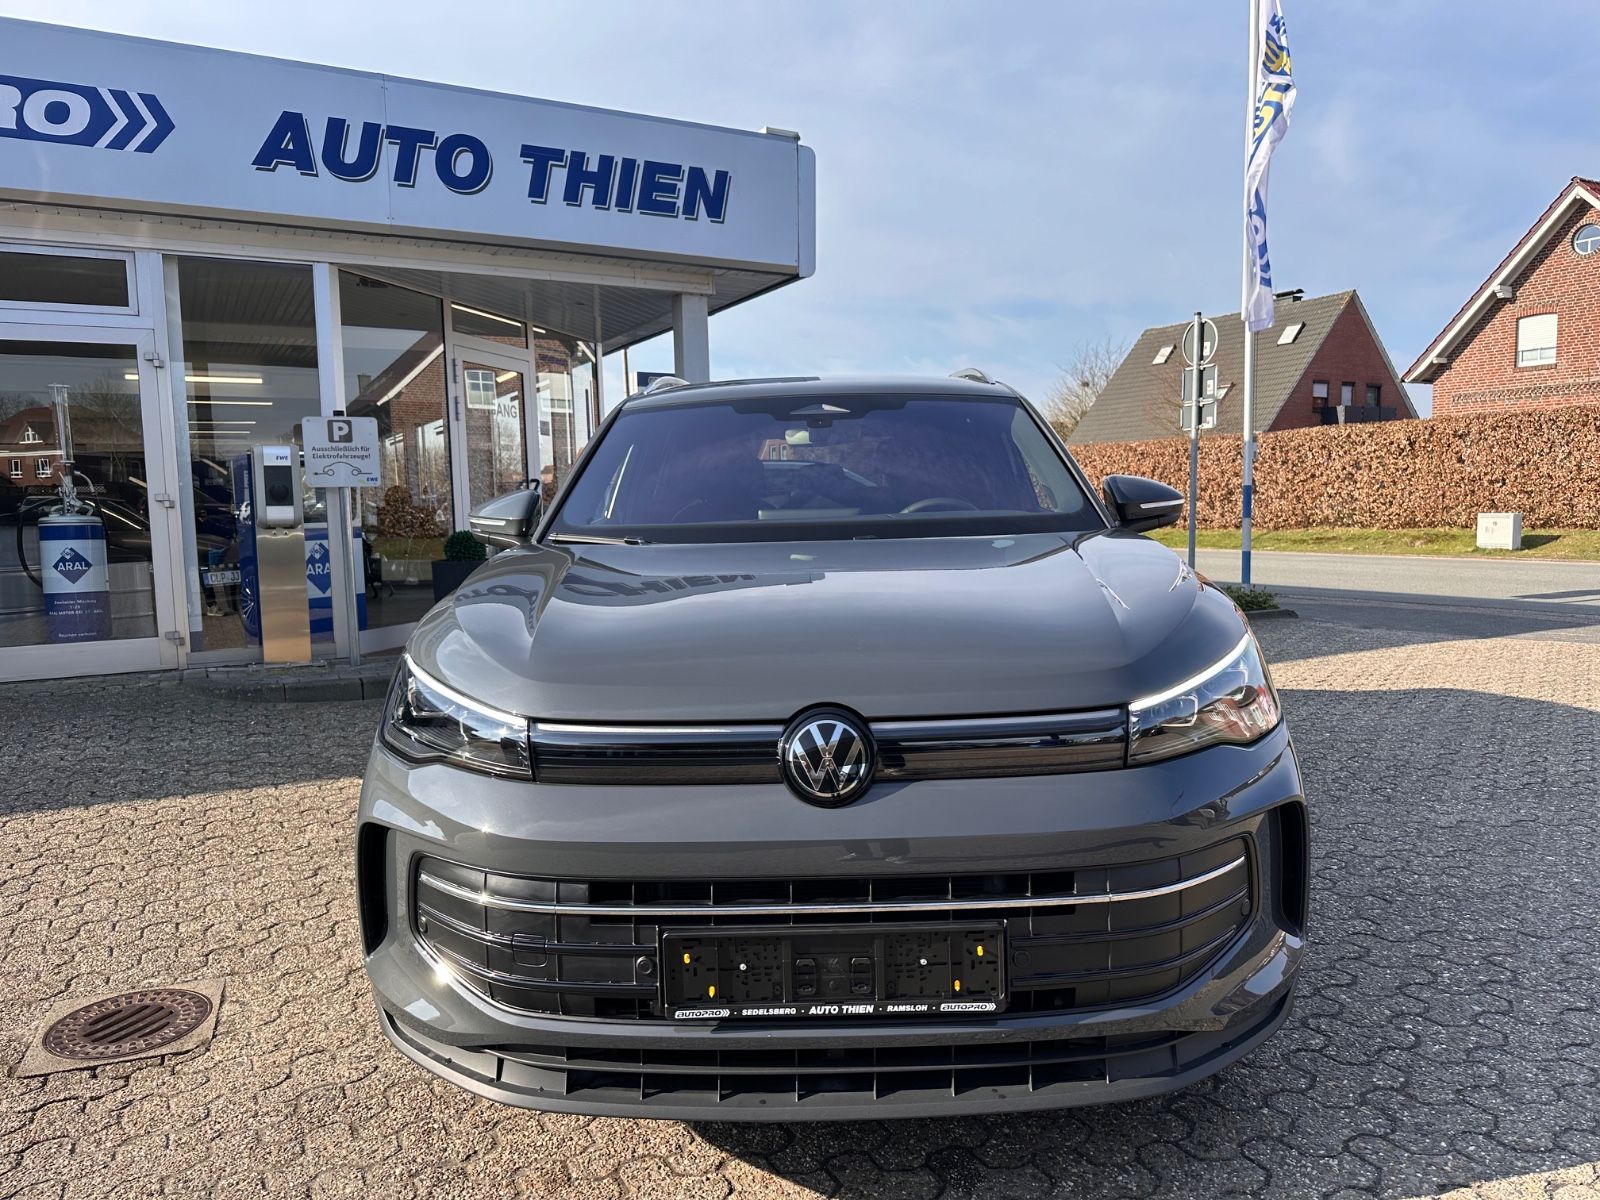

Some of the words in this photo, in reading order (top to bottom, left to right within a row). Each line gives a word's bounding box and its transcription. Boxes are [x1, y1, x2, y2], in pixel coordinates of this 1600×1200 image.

[251, 110, 493, 195] AUTO
[519, 143, 732, 224] THIEN
[332, 421, 350, 442] P
[57, 561, 89, 571] ARAL
[741, 1007, 797, 1016] SEDELSBERG
[808, 1005, 839, 1015] AUTO
[841, 1004, 874, 1014] THIEN
[886, 1004, 928, 1012] RAMSLOH
